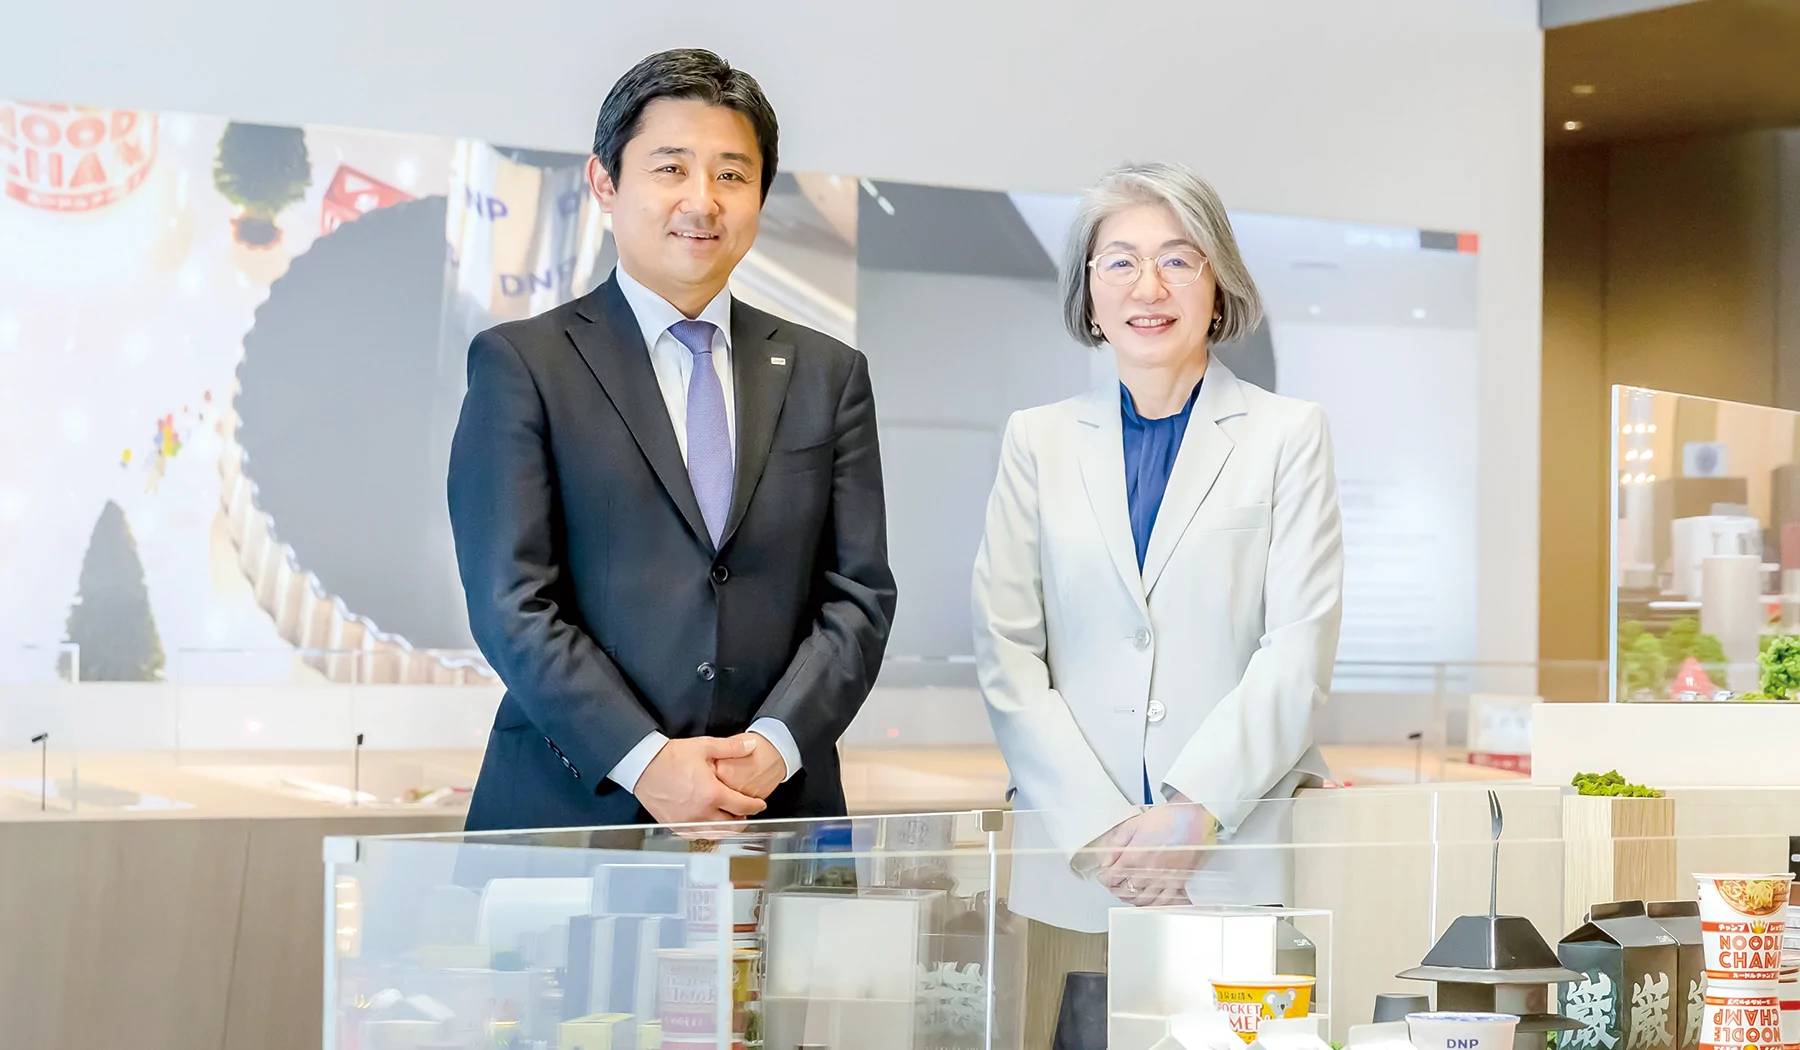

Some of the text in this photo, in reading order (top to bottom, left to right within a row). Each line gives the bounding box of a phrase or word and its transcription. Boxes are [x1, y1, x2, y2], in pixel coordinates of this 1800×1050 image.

[1713, 1009, 1779, 1026] CHAMP
[1714, 1027, 1781, 1043] NOODLE
[1447, 1039, 1479, 1049] DNP
